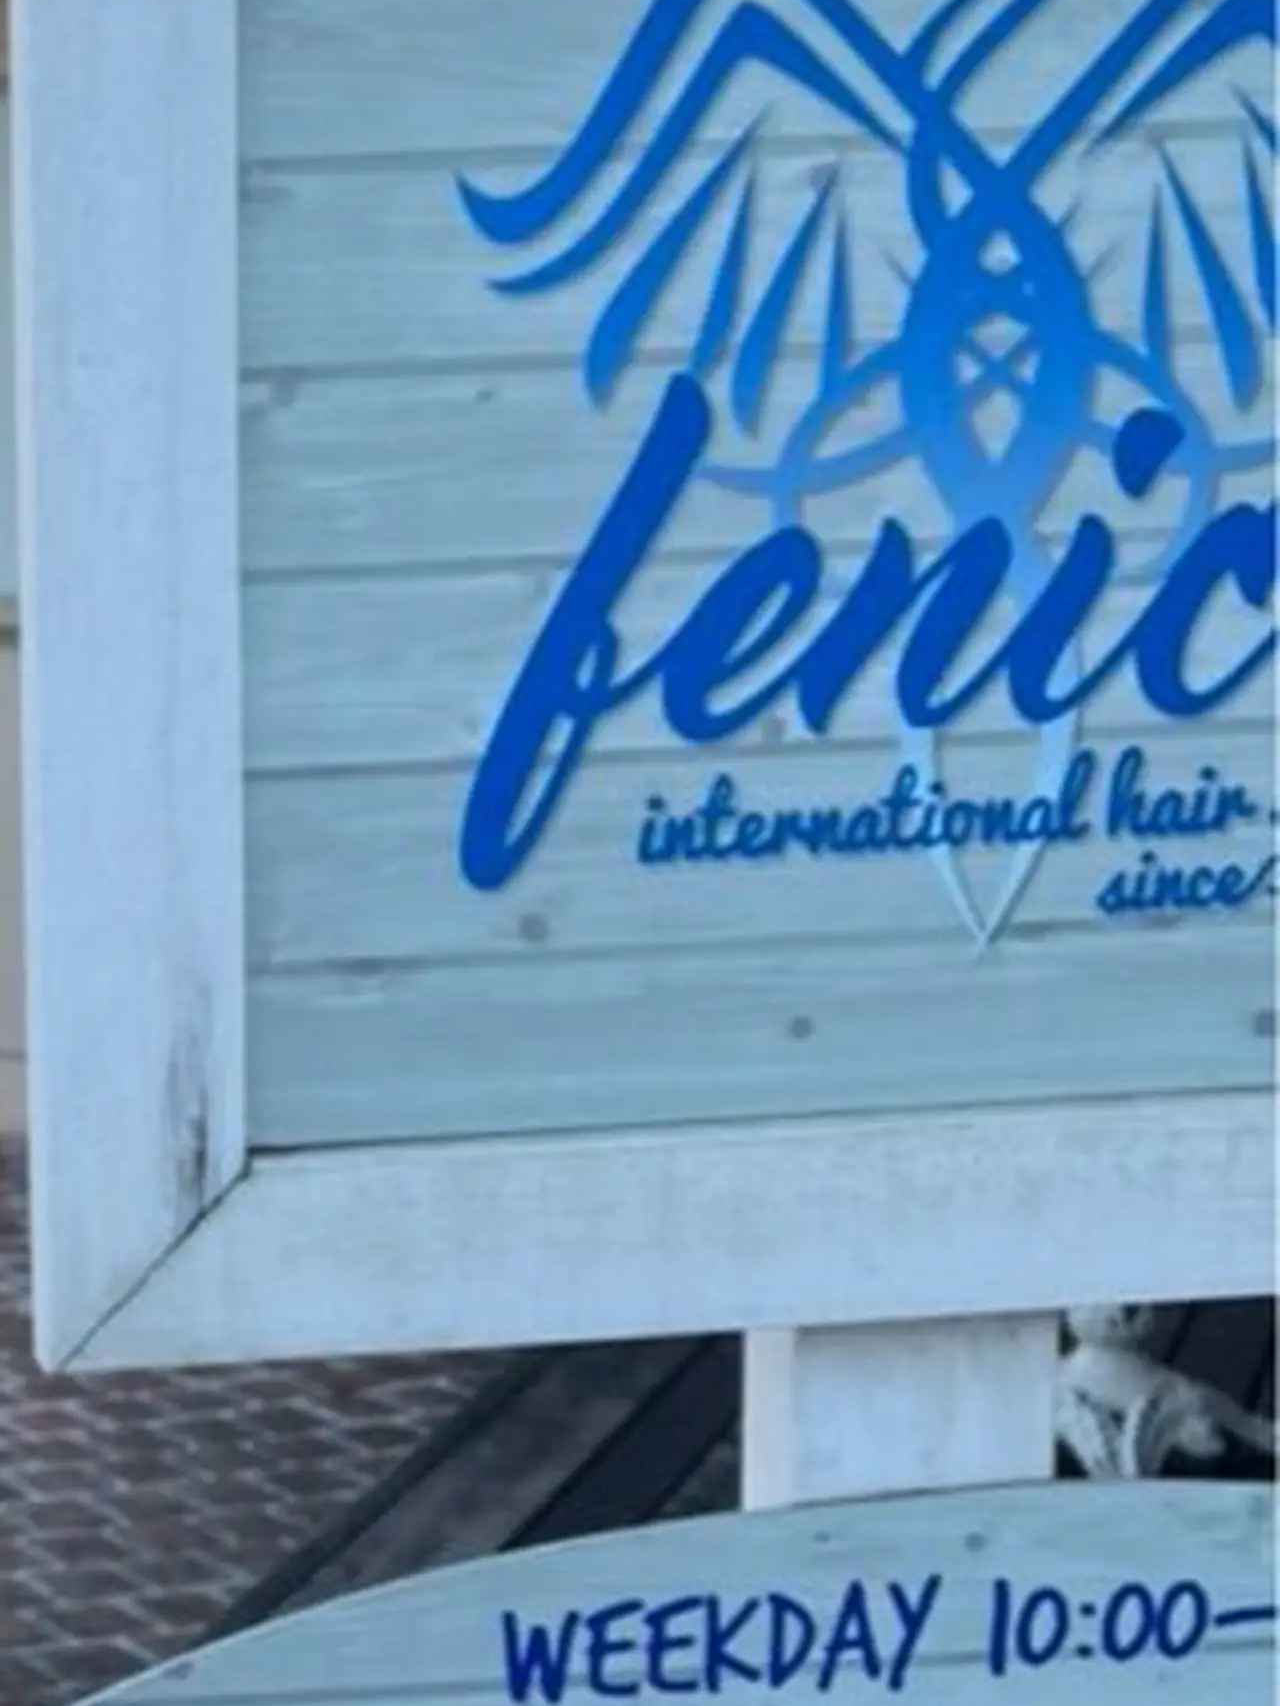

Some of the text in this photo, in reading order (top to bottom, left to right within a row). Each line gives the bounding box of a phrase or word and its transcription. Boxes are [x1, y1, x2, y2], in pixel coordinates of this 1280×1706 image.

[637, 745, 1258, 864] international hair
[502, 1573, 942, 1705] WEEKDAY
